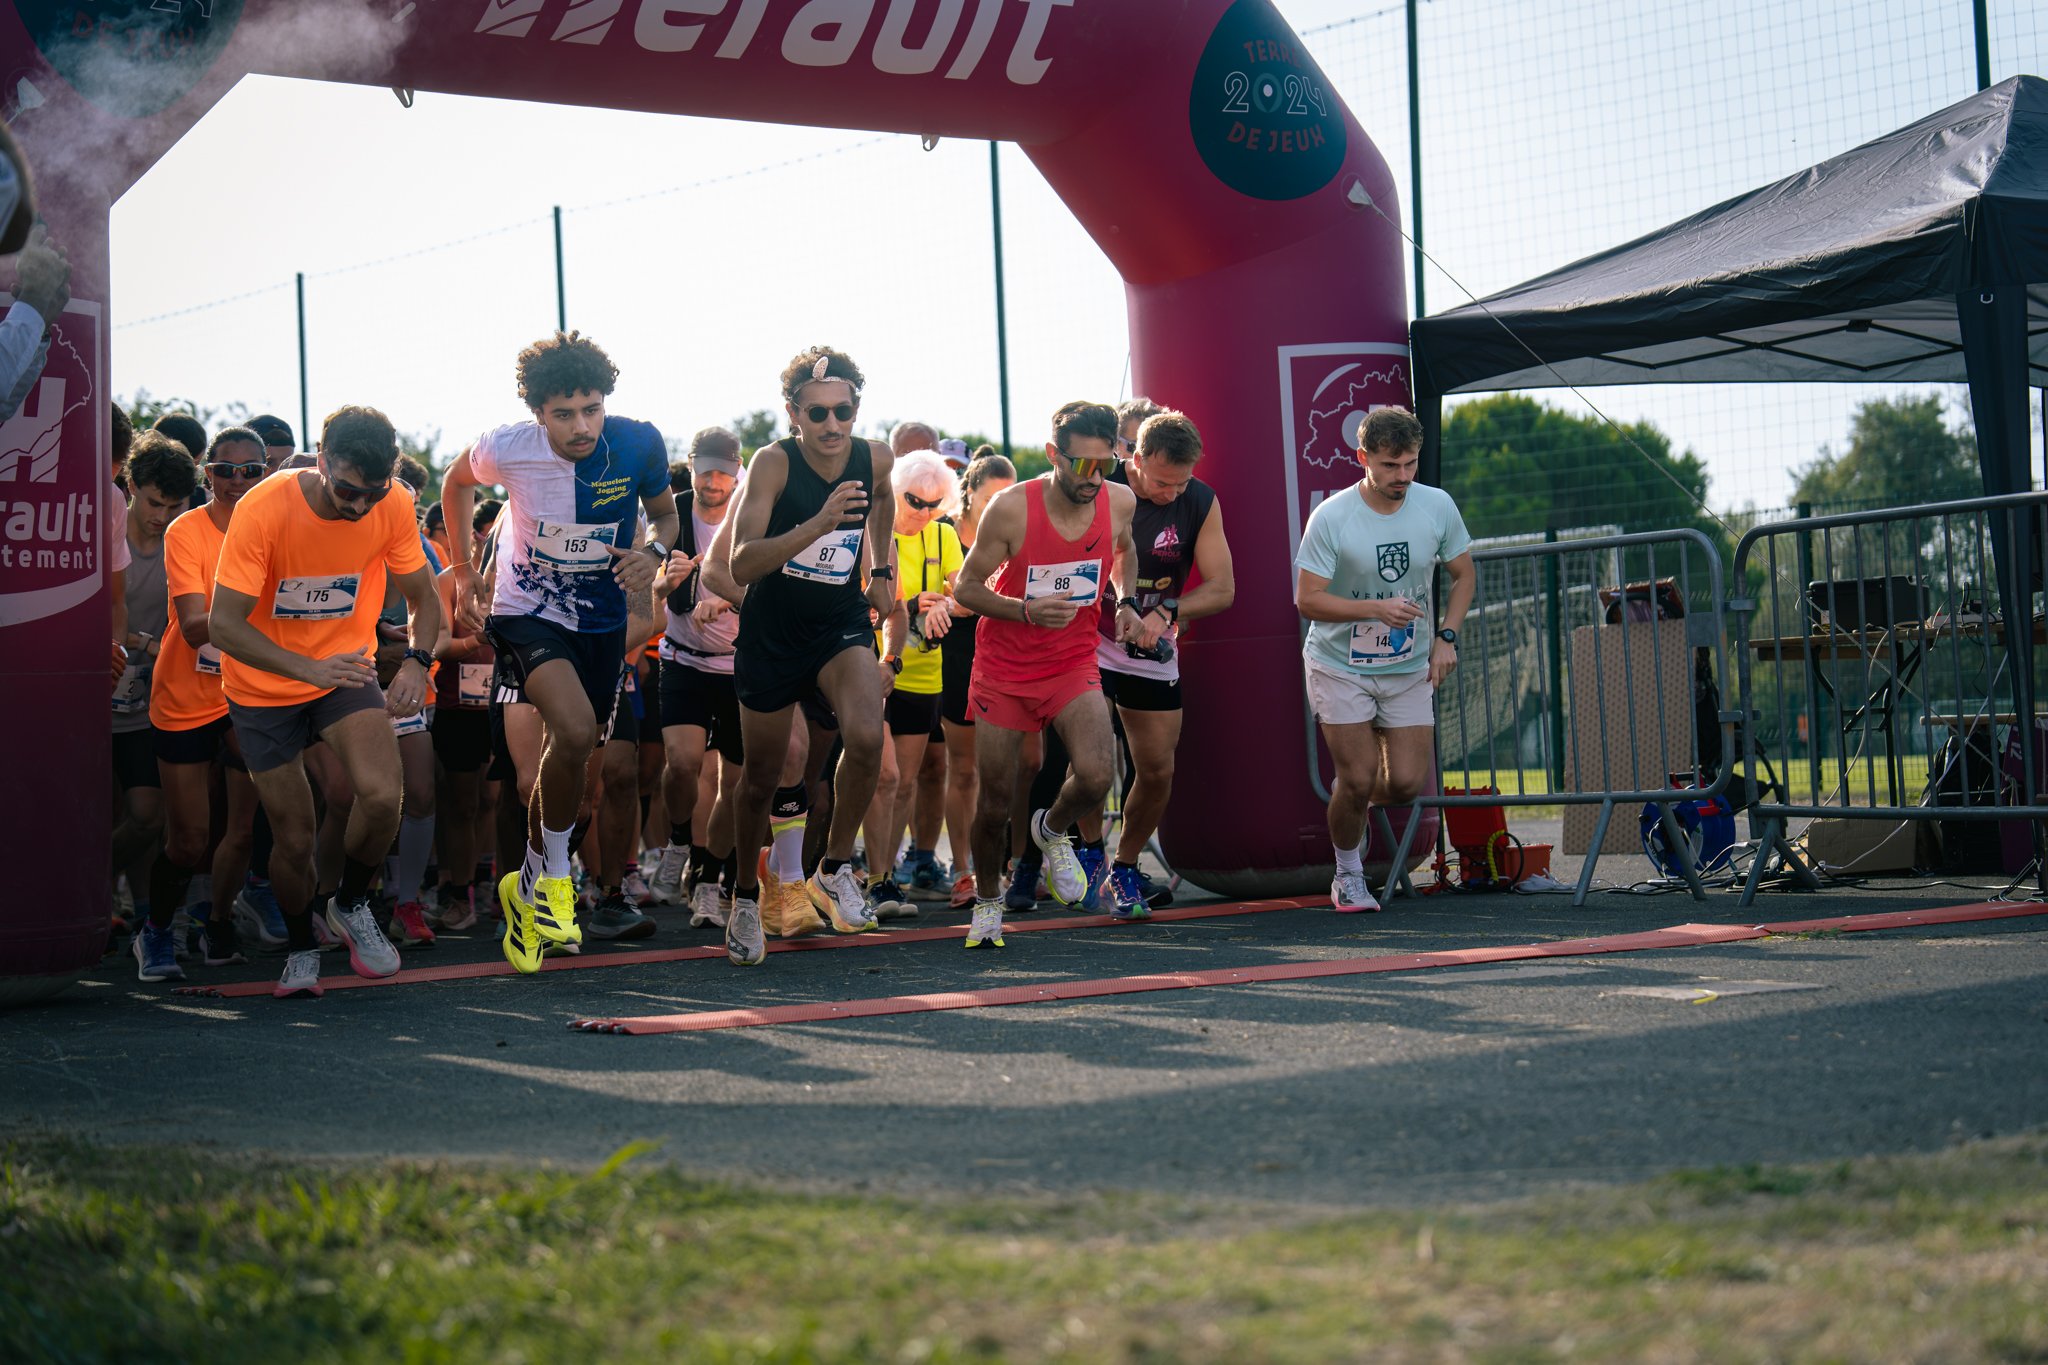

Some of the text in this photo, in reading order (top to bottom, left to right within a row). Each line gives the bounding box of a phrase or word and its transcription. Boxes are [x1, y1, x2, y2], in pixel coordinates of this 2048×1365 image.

[1222, 71, 1327, 117] 2024
[1227, 121, 1326, 152] DE JEUX
[591, 476, 632, 488] Maguelone
[596, 485, 627, 495] Jogging
[564, 539, 588, 553] 153
[1, 544, 93, 570] tement
[819, 547, 837, 562] 87
[1054, 577, 1071, 590] 88
[305, 589, 330, 603] 175
